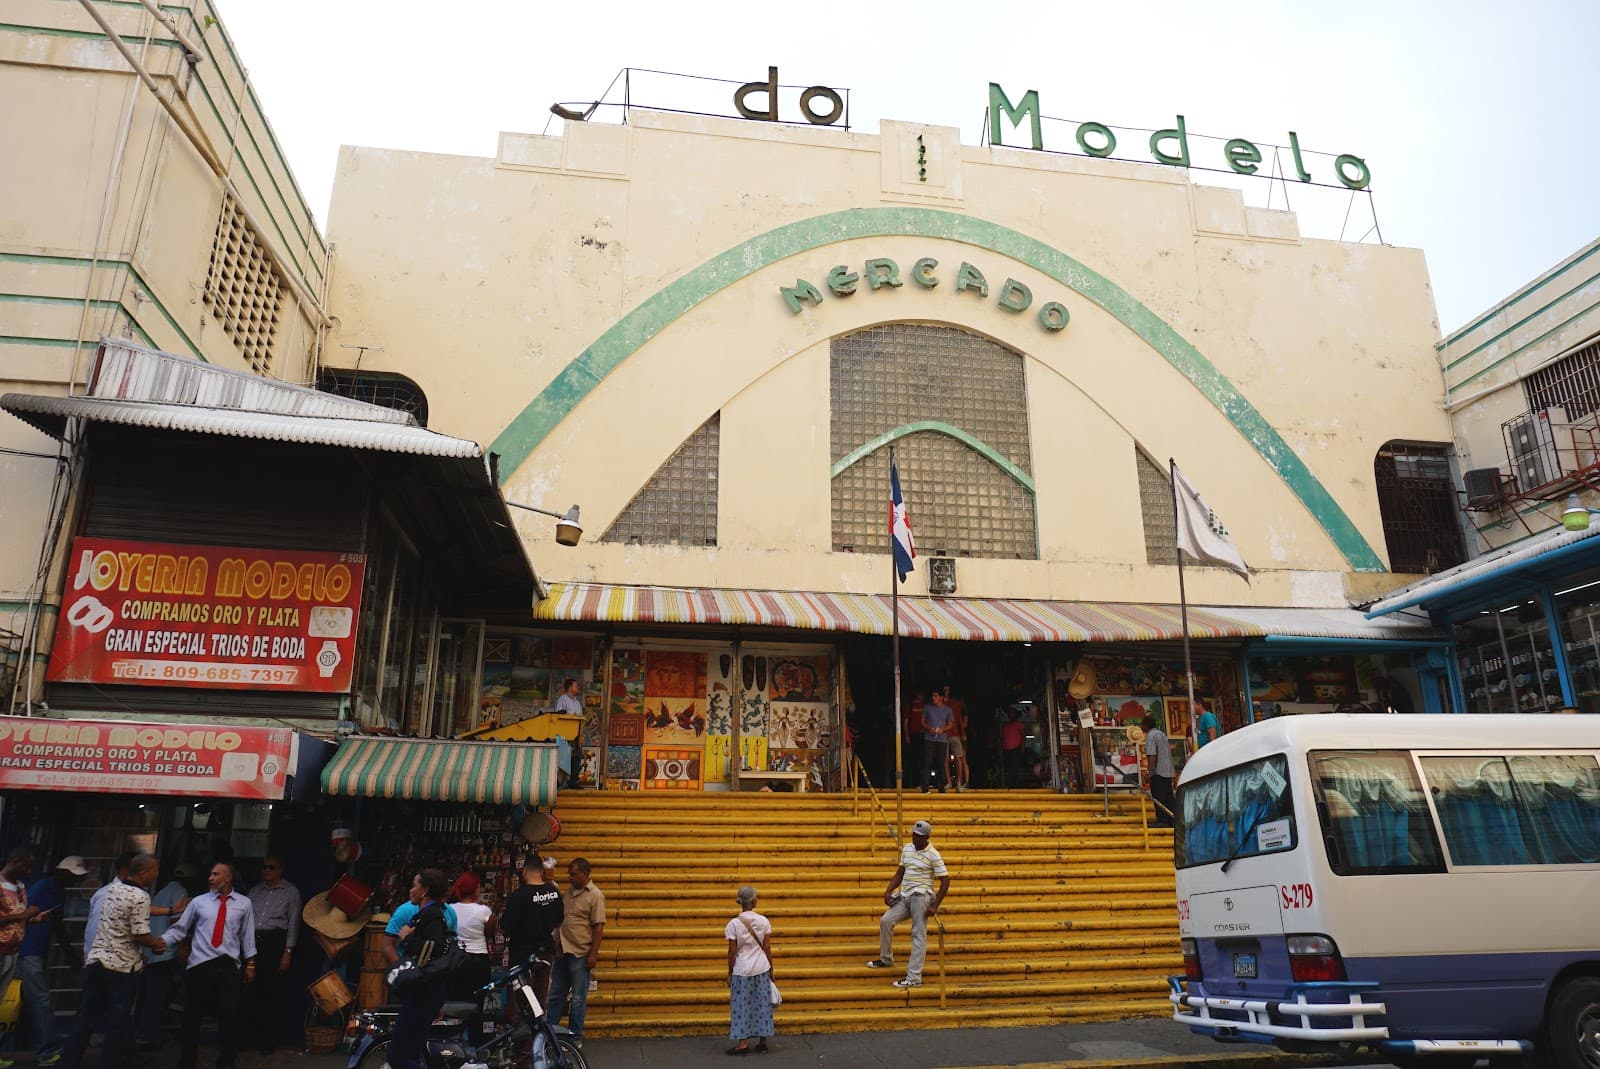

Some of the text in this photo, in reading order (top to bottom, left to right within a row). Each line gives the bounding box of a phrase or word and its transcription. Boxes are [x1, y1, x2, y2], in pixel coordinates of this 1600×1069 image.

[734, 66, 1371, 190] do Modelo
[779, 256, 1070, 333] MERCADO
[74, 550, 352, 603] JOYERIA MODELO
[121, 599, 300, 628] COMPRAMOS ORO Y PLATA
[105, 628, 306, 660] GRAN ESPECIAL TRIOS DE BODA
[112, 661, 298, 683] Tel.: 809-685-7397
[107, 727, 242, 751] MODELO
[13, 743, 198, 762] COMPRAMOS ORO Y PLATA
[0, 757, 215, 776] RAN ESPECIAL TRIOS DE BODA
[532, 891, 559, 903] alorica
[1281, 883, 1313, 909] S-279
[1214, 923, 1251, 932] COASTER
